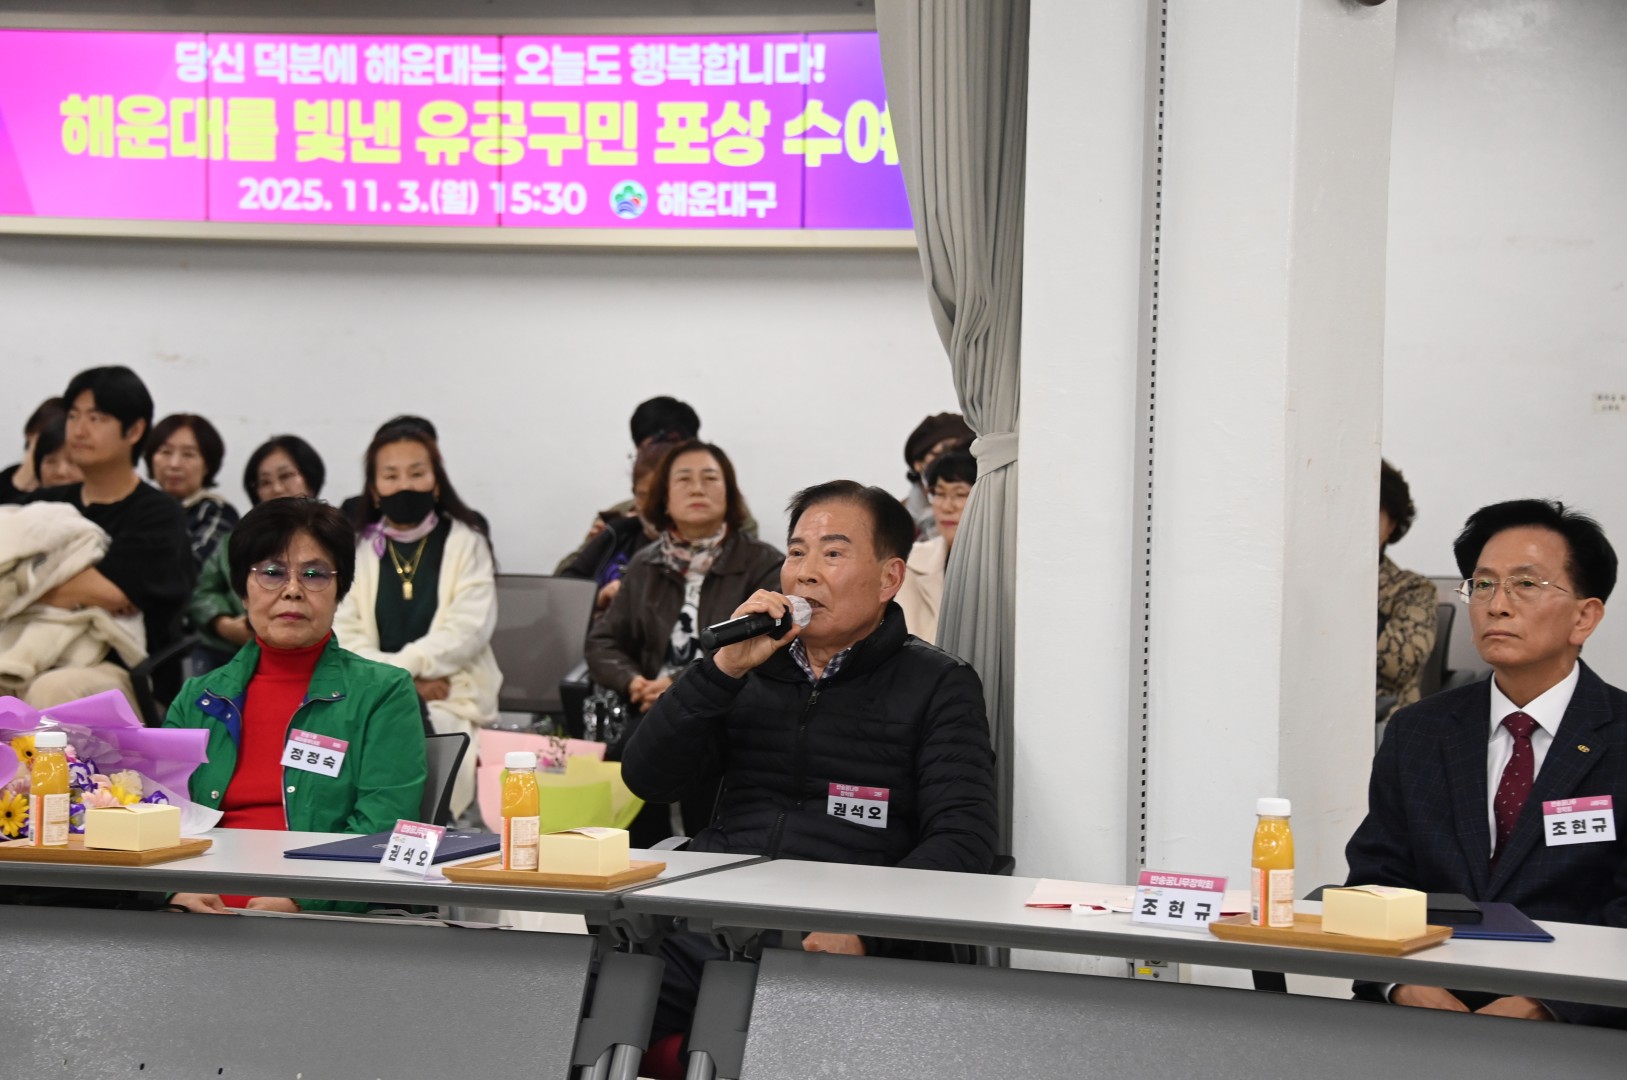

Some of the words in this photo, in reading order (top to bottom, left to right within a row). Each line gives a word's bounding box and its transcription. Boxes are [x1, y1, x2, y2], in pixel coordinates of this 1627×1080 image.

[175, 42, 245, 83] 당신
[254, 44, 356, 85] 덕분에
[364, 45, 506, 86] 해운대는
[514, 45, 621, 85] 오늘도
[629, 44, 826, 85] 행복합니다!
[59, 94, 278, 162] 해운대를
[293, 99, 401, 164] 빛낸
[415, 99, 638, 166] 유공구민
[653, 100, 771, 166] 포상
[239, 179, 332, 211] 2025.
[343, 181, 391, 212] 11.
[490, 182, 587, 215] 15:30
[657, 181, 777, 218] 해운대구
